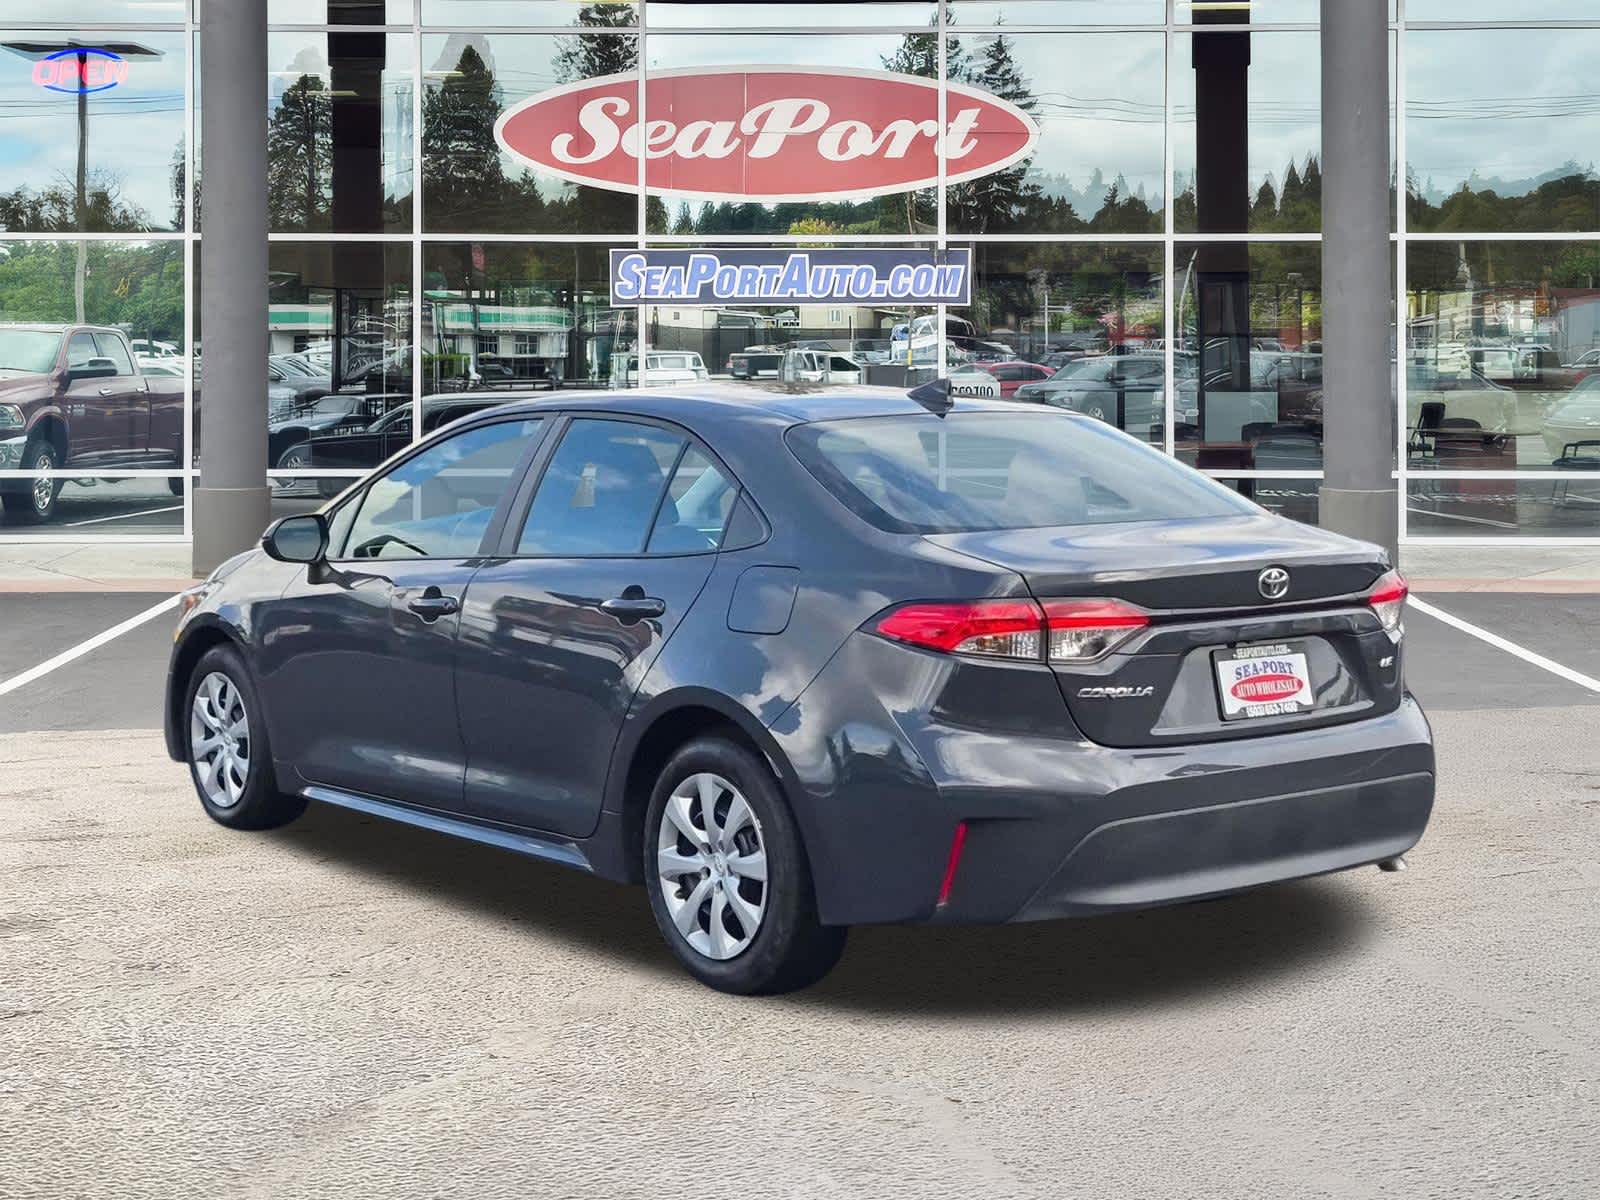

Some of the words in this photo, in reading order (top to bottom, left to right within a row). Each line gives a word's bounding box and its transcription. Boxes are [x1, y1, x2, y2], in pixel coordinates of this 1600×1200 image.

[33, 60, 128, 86] OPEN
[550, 96, 981, 165] SeaPort
[1077, 686, 1154, 698] COROLLA
[1236, 683, 1257, 697] AUTO
